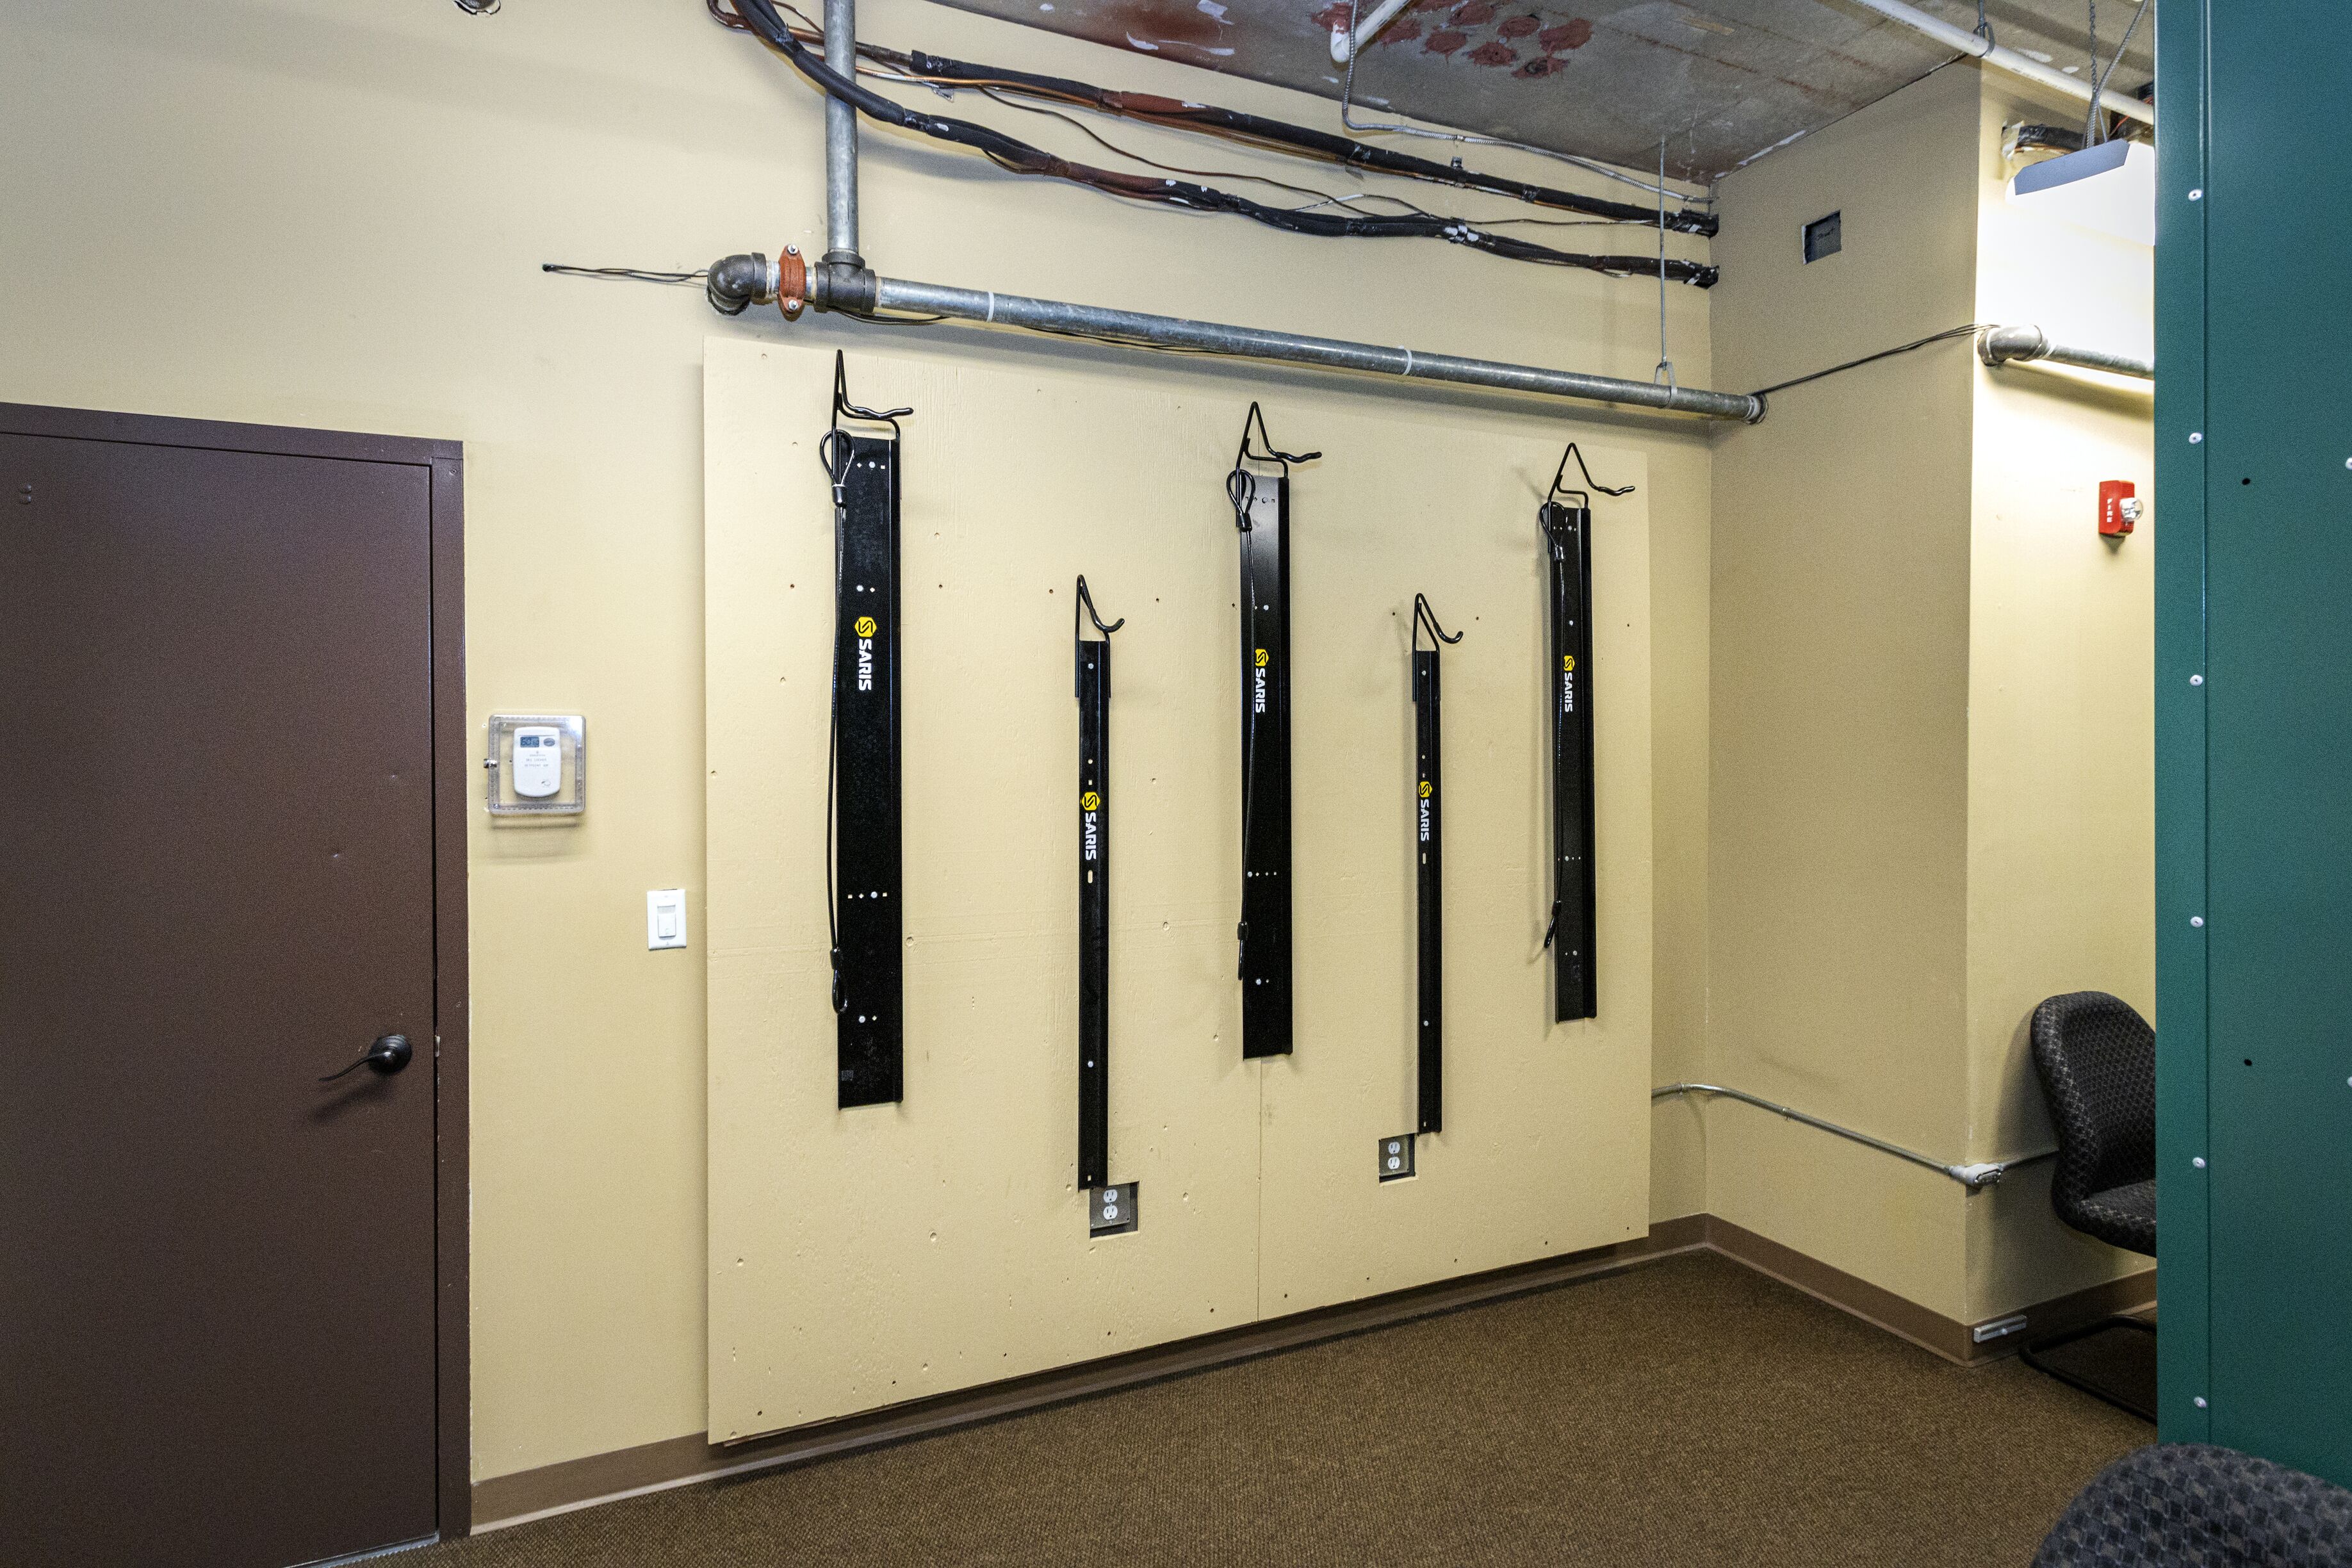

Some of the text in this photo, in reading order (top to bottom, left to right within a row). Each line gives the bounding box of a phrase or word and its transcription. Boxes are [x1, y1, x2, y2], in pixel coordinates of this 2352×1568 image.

[858, 638, 872, 691] SARIS
[1255, 668, 1266, 713] SARIS
[1565, 673, 1573, 712] SARIS
[1085, 812, 1097, 861] SARIS
[1421, 799, 1430, 842] SARIS
